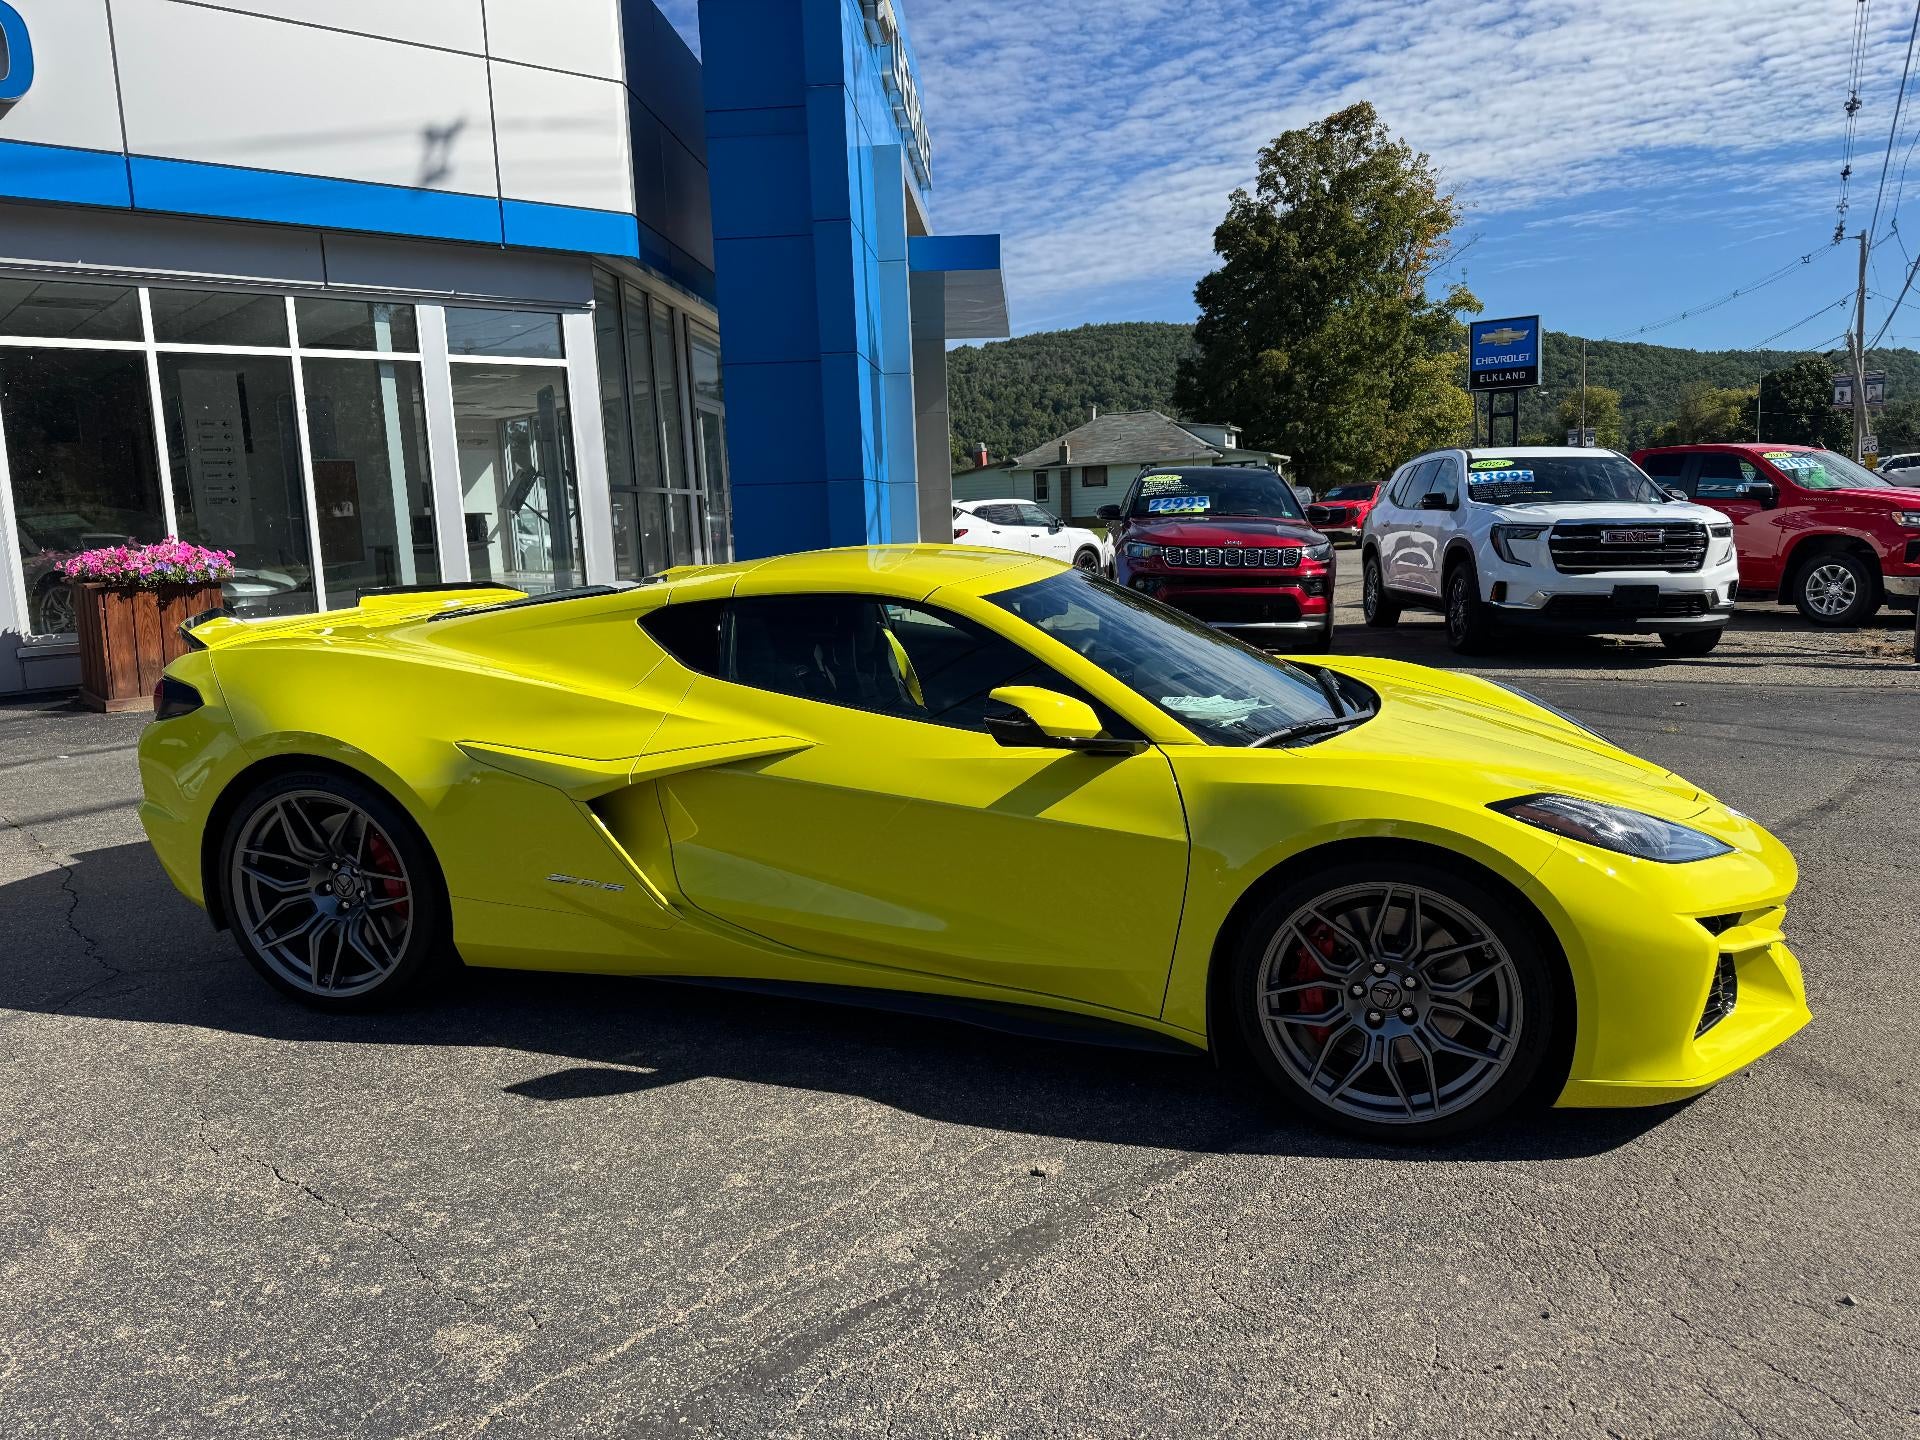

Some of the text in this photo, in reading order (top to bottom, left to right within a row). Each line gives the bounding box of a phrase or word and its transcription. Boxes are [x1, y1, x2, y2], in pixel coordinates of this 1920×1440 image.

[1475, 353, 1530, 366] CHEVROLET
[1480, 371, 1526, 383] ELKLAND
[1470, 471, 1533, 483] 33995
[1150, 496, 1208, 510] 22995
[1607, 531, 1661, 542] GMC
